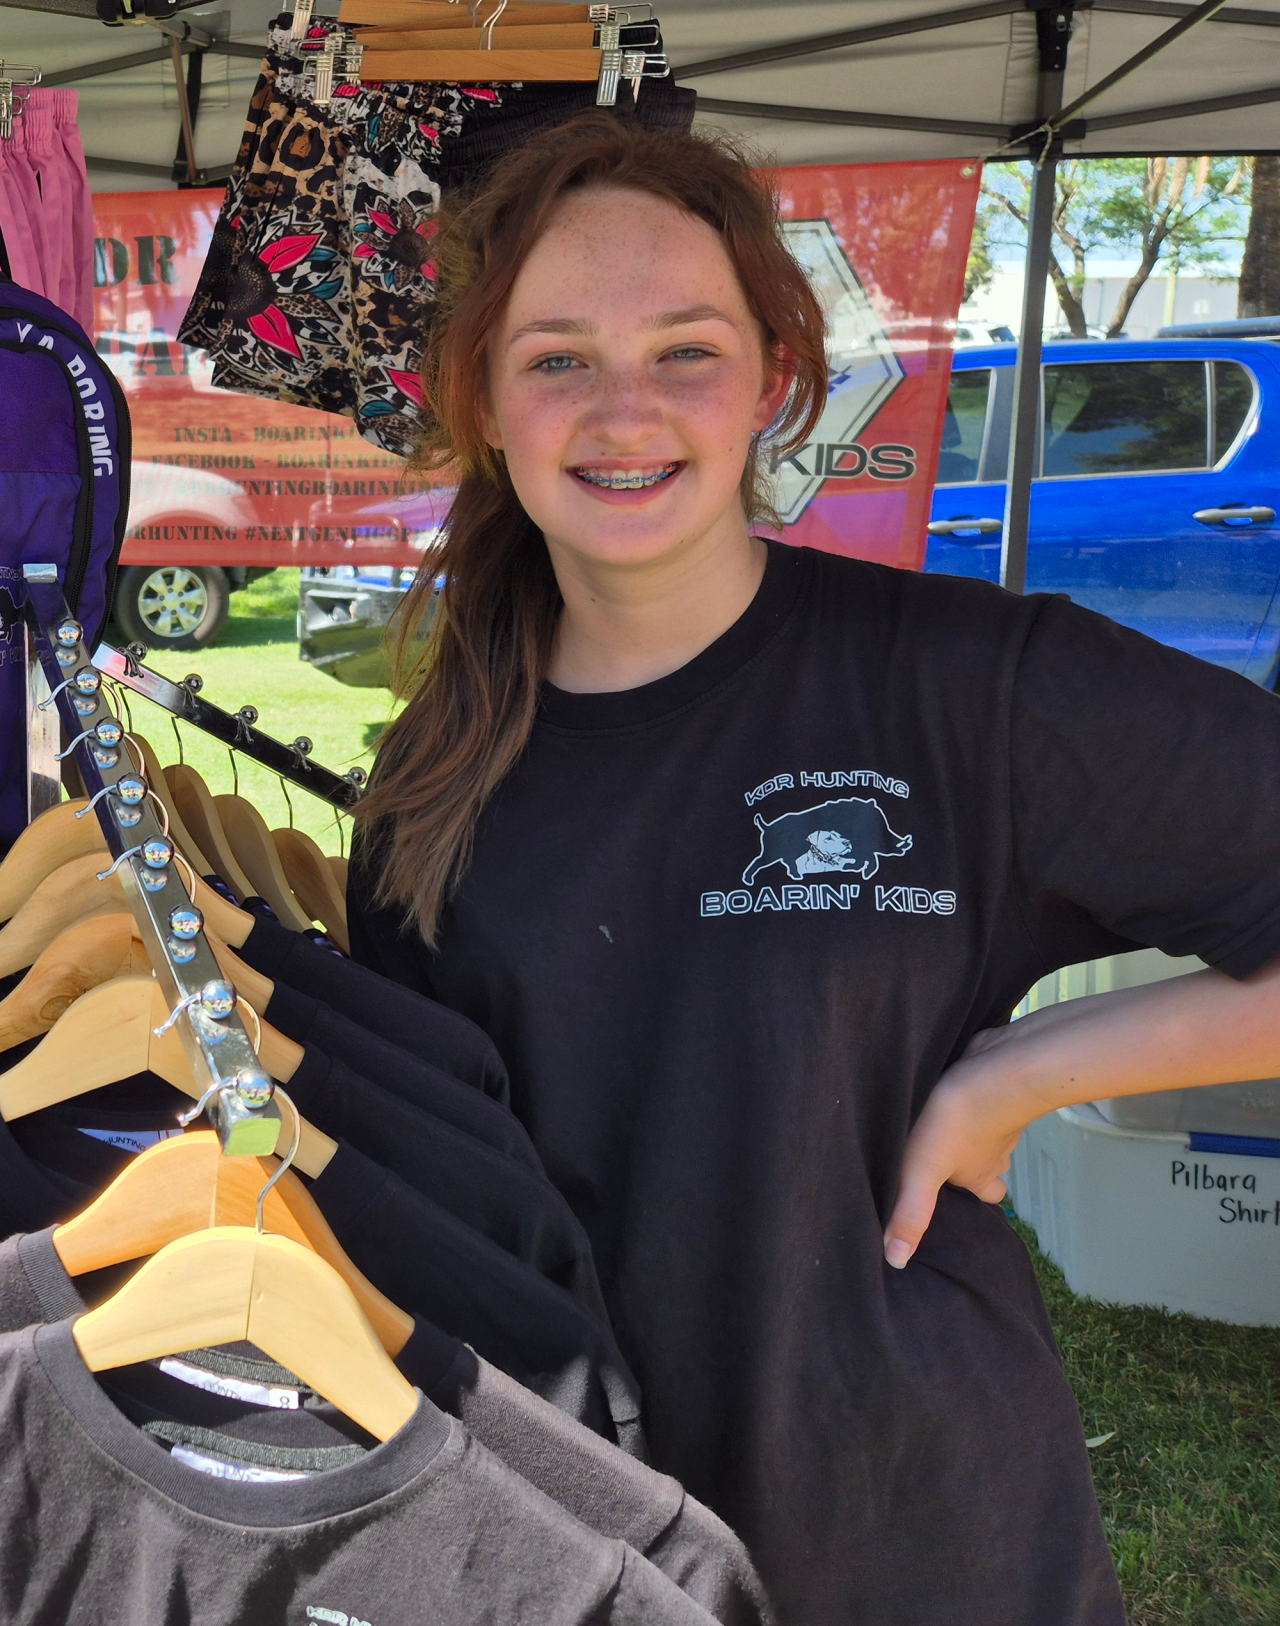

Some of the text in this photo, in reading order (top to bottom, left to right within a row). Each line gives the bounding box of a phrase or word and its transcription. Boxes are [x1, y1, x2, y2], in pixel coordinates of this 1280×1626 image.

[94, 235, 181, 287] DR
[67, 354, 113, 477] BORING
[174, 426, 232, 442] INSTA
[253, 425, 357, 441] BOARINKI
[151, 454, 256, 469] FACEBOOK
[769, 443, 917, 481] KIDS
[124, 526, 237, 541] DRHUNTING
[744, 770, 910, 806] KDR HUNTING
[700, 884, 957, 917] BOARIN' KIDS
[1172, 1160, 1257, 1194] Pilbara
